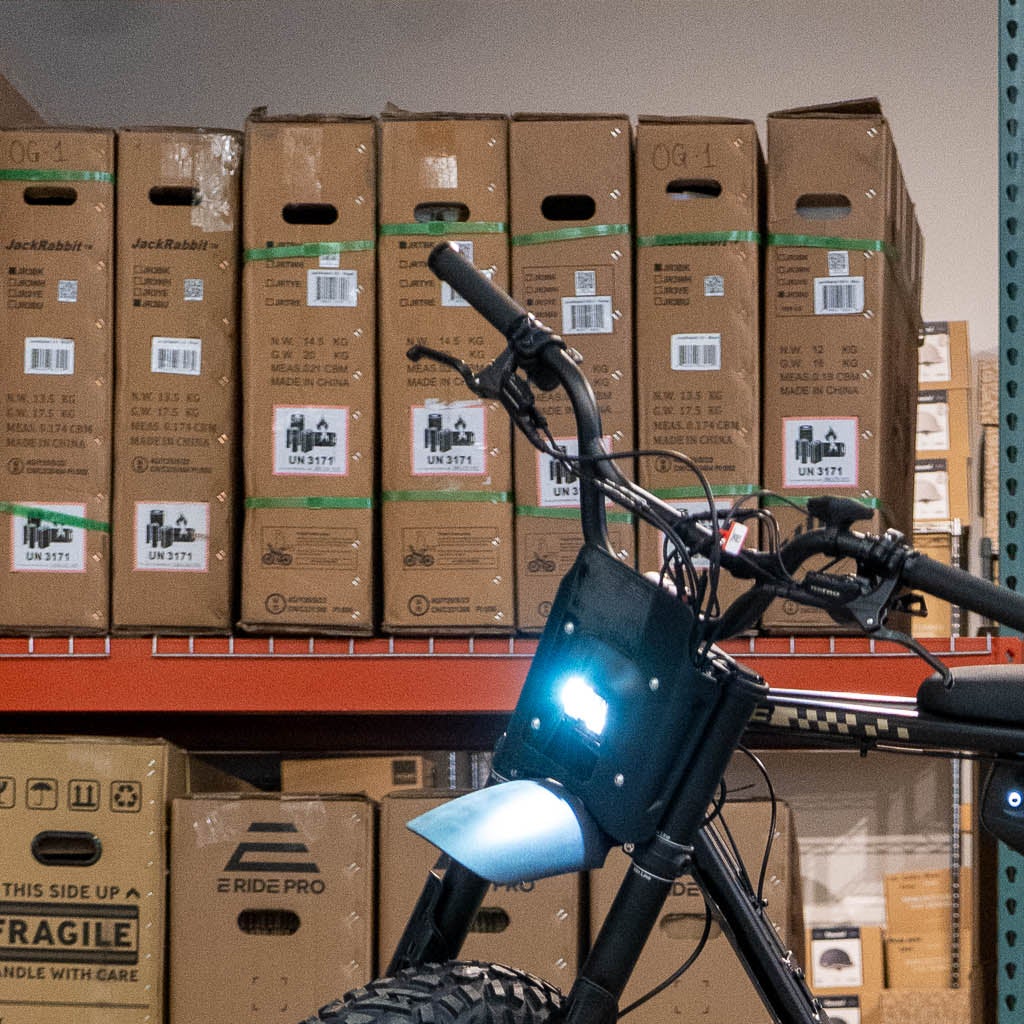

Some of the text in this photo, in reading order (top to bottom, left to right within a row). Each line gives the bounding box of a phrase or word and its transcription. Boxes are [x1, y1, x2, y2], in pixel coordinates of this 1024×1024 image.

[468, 337, 484, 345] KG
[841, 345, 858, 354] KG
[842, 359, 858, 368] KG
[271, 378, 301, 386] MADE
[317, 378, 349, 387] CHINA
[407, 378, 437, 387] MADE
[780, 386, 859, 396] MADE IN CHINA
[699, 436, 732, 446] CHINA
[288, 455, 334, 466] UN 3171
[427, 455, 472, 465] UN 3171
[798, 467, 843, 477] UN 3171
[553, 487, 569, 497] UN
[25, 552, 70, 562] UN 3171
[148, 551, 192, 561] UN 3171
[3, 882, 119, 899] THIS SIDE UP
[284, 879, 325, 894] PRO
[50, 967, 91, 980] WITH
[96, 968, 138, 982] CARE
